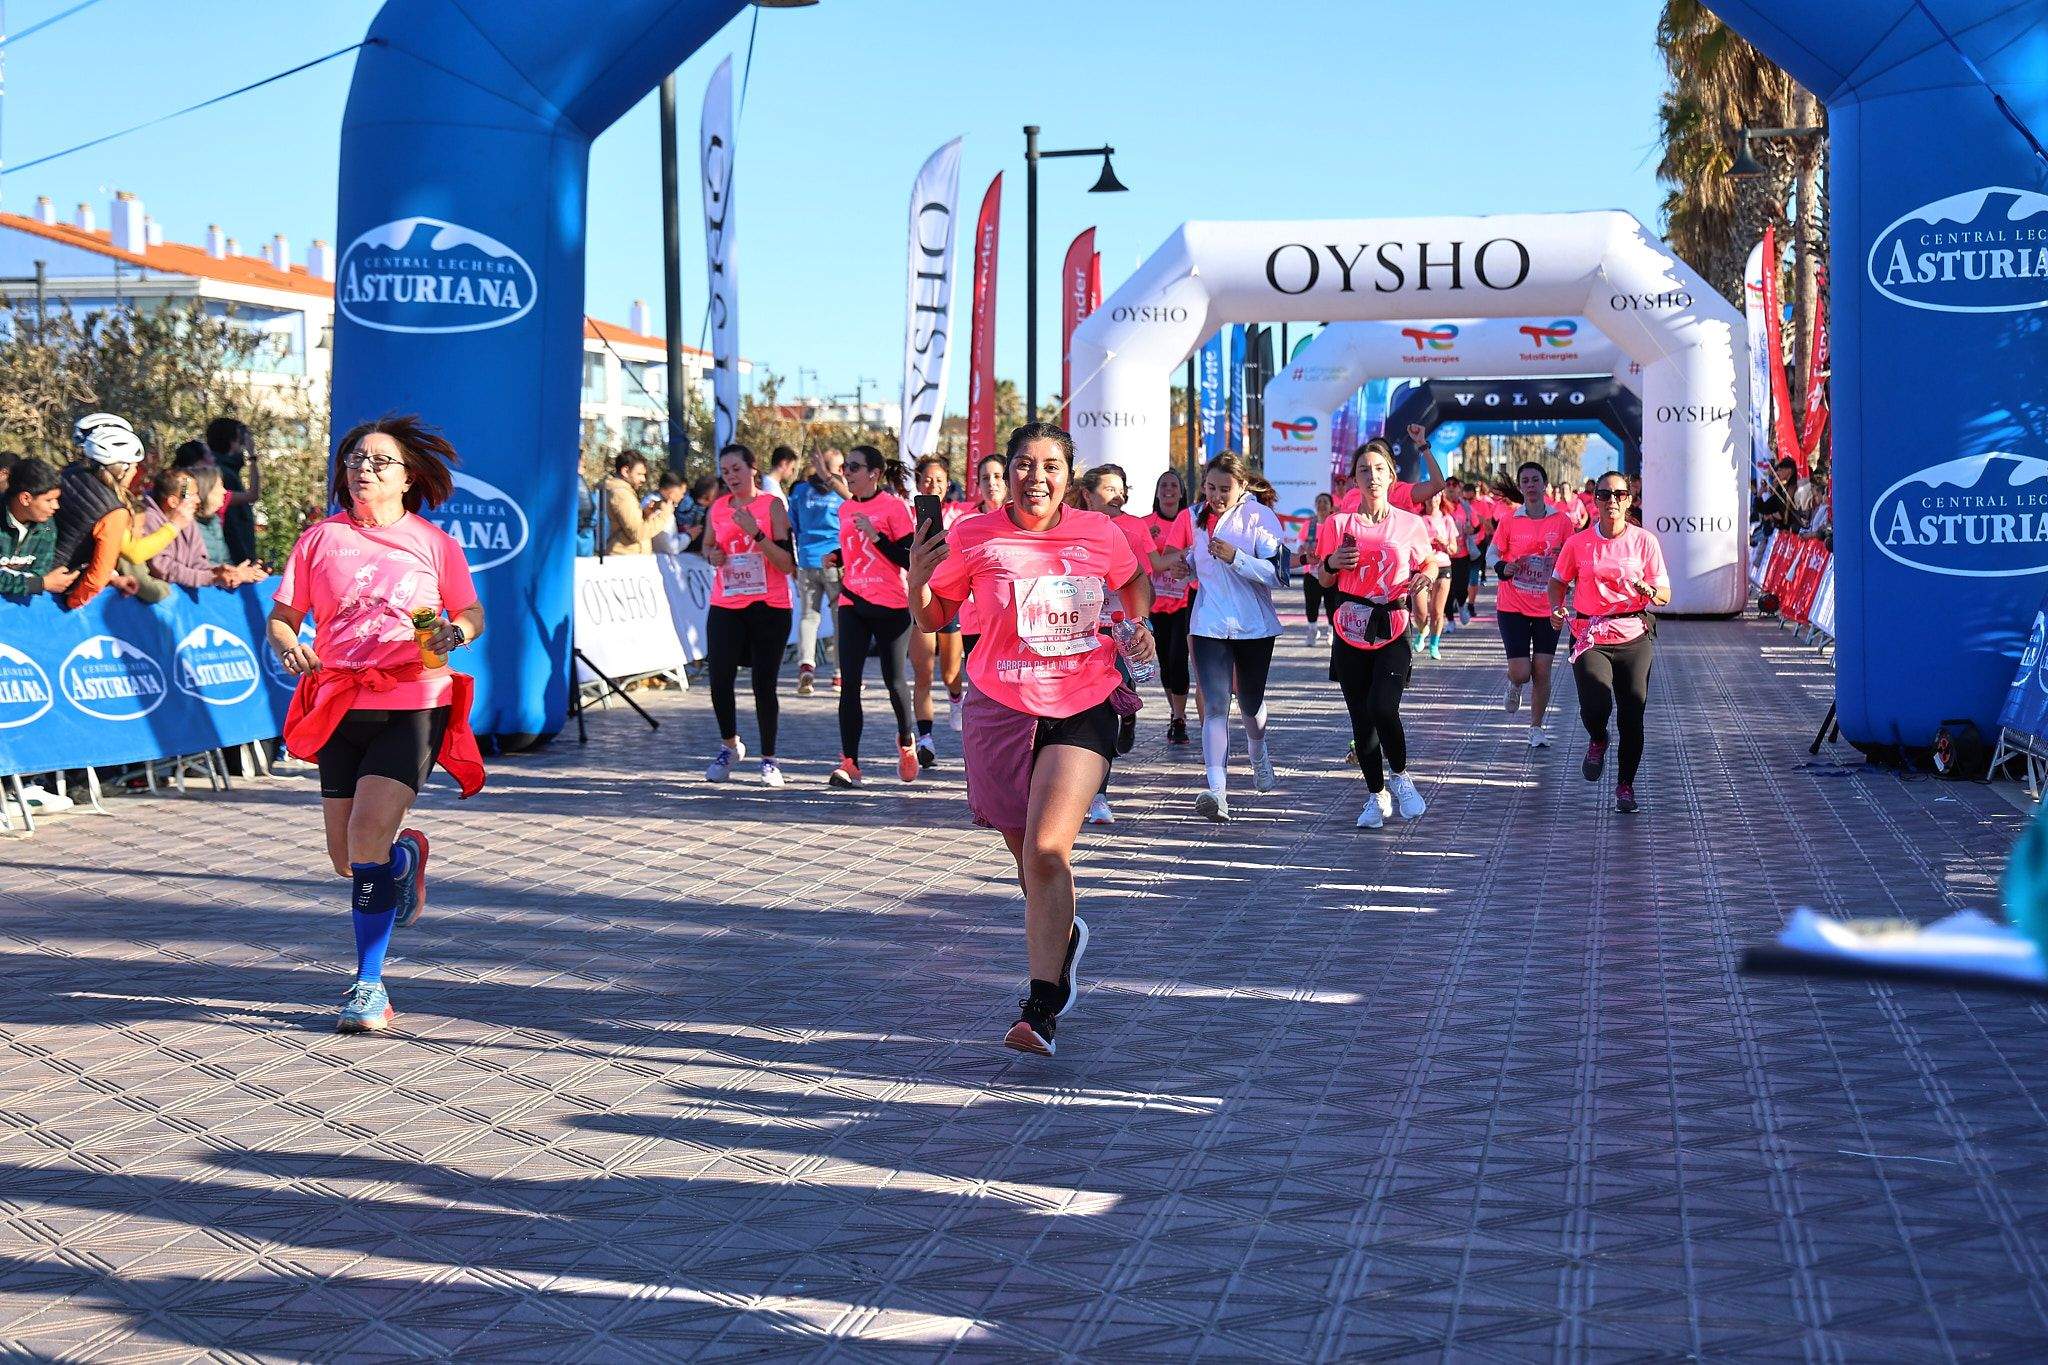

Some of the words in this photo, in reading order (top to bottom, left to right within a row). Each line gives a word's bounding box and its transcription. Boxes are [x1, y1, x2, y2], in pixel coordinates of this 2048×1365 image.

[1920, 230, 2006, 246] CENTRAL
[364, 256, 430, 269] CENTRAL
[438, 259, 516, 274] LECHERA
[1266, 237, 1530, 295] OYSHO
[343, 260, 521, 309] ASTURIANA
[1611, 291, 1693, 311] OYSHO
[1112, 306, 1187, 323] OYSHO
[1403, 354, 1460, 364] TotalEnergies
[1519, 351, 1579, 362] TotalEnergies
[1455, 392, 1586, 406] VOLVO
[1077, 411, 1146, 428] OYSHO
[1657, 405, 1732, 424] OYSHO
[1922, 496, 2007, 509] CENTRAL
[1656, 517, 1731, 533] OYSHO
[1048, 611, 1079, 625] 016
[996, 660, 1032, 670] CARRERA
[72, 667, 162, 700] ASTURIANA
